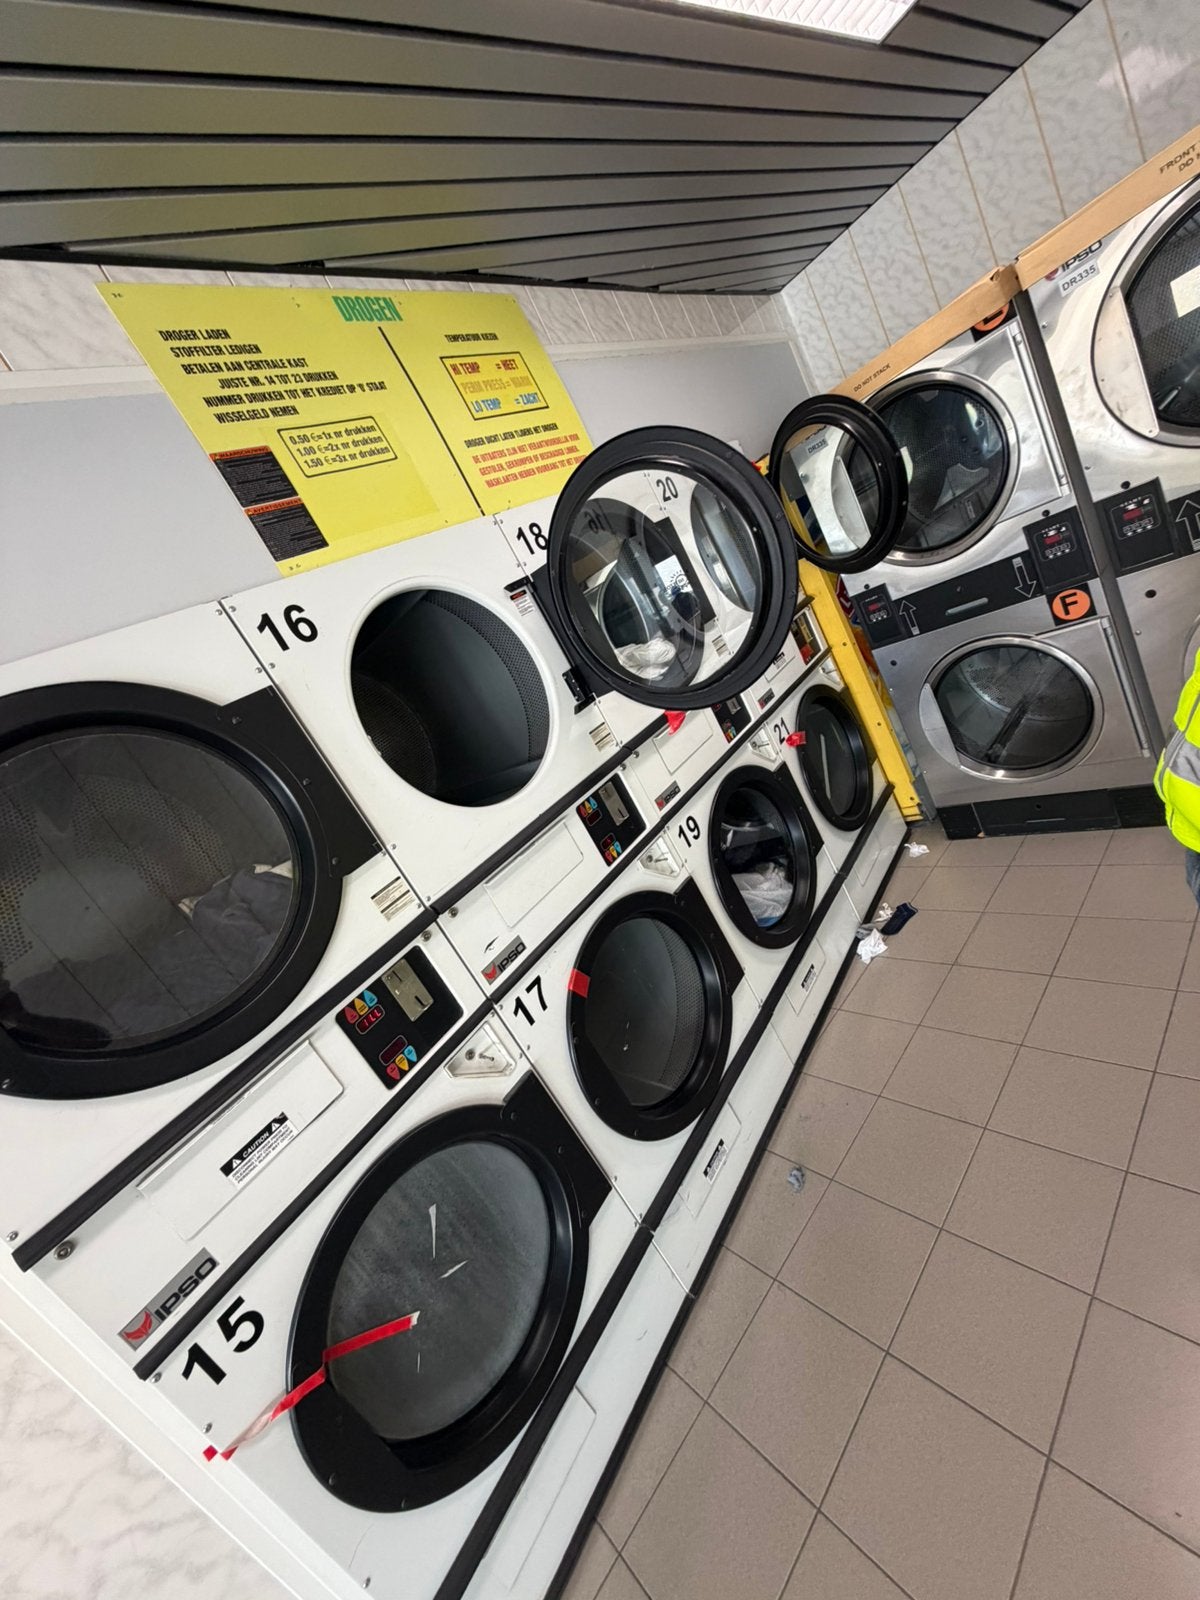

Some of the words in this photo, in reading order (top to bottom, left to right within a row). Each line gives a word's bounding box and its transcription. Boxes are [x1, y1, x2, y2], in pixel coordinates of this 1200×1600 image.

[1160, 144, 1196, 173] FRONT
[1179, 158, 1194, 172] DO
[1062, 240, 1102, 272] IPSO
[1062, 264, 1096, 291] DR335
[332, 296, 403, 322] DROGEN
[158, 330, 198, 342] DROGER
[200, 328, 231, 340] LADEN
[170, 346, 225, 358] STOFFILTER
[226, 344, 262, 355] LEDIGEN
[181, 362, 222, 375] BETALEN
[224, 360, 245, 372] AAN
[245, 359, 286, 370] CENTRALE
[287, 357, 308, 368] KAST
[450, 363, 462, 376] HI
[459, 362, 480, 374] TEMP
[500, 359, 519, 370] HEET
[853, 384, 862, 392] DO
[862, 376, 872, 386] NOT
[873, 363, 891, 378] STACK
[218, 376, 249, 390] JUISTE
[250, 375, 265, 387] NR.
[265, 375, 277, 385] 14
[276, 374, 291, 384] TOT
[302, 371, 339, 382] DRUKKEN
[203, 393, 246, 408] NUMMER
[246, 390, 285, 404] DRUKKEN
[284, 388, 300, 400] TOT
[300, 387, 316, 398] HET
[317, 385, 347, 396] KREDIET
[346, 384, 356, 394] OP
[368, 381, 387, 392] STAAT
[471, 400, 483, 413] LO
[481, 398, 502, 411] TEMP
[214, 408, 269, 424] WISSELGELD
[269, 405, 300, 417] NEMEN
[289, 434, 311, 445] 0.50
[334, 429, 344, 438] nr
[344, 425, 376, 437] drukken
[297, 445, 317, 456] 1.00
[340, 441, 350, 450] nr
[351, 435, 383, 448] drukken
[304, 457, 324, 469] 1.50
[349, 452, 359, 461] nr
[358, 446, 390, 459] drukken
[656, 477, 678, 502] 20
[517, 522, 548, 555] 18
[1059, 592, 1078, 616] F
[257, 604, 318, 651] 16
[774, 717, 790, 745] 21
[678, 816, 701, 848] 19
[497, 942, 526, 973] IPSO
[513, 975, 548, 1026] 17
[242, 1132, 269, 1158] CAUTION
[154, 1257, 216, 1321] IPSO
[182, 1296, 264, 1385] 15
